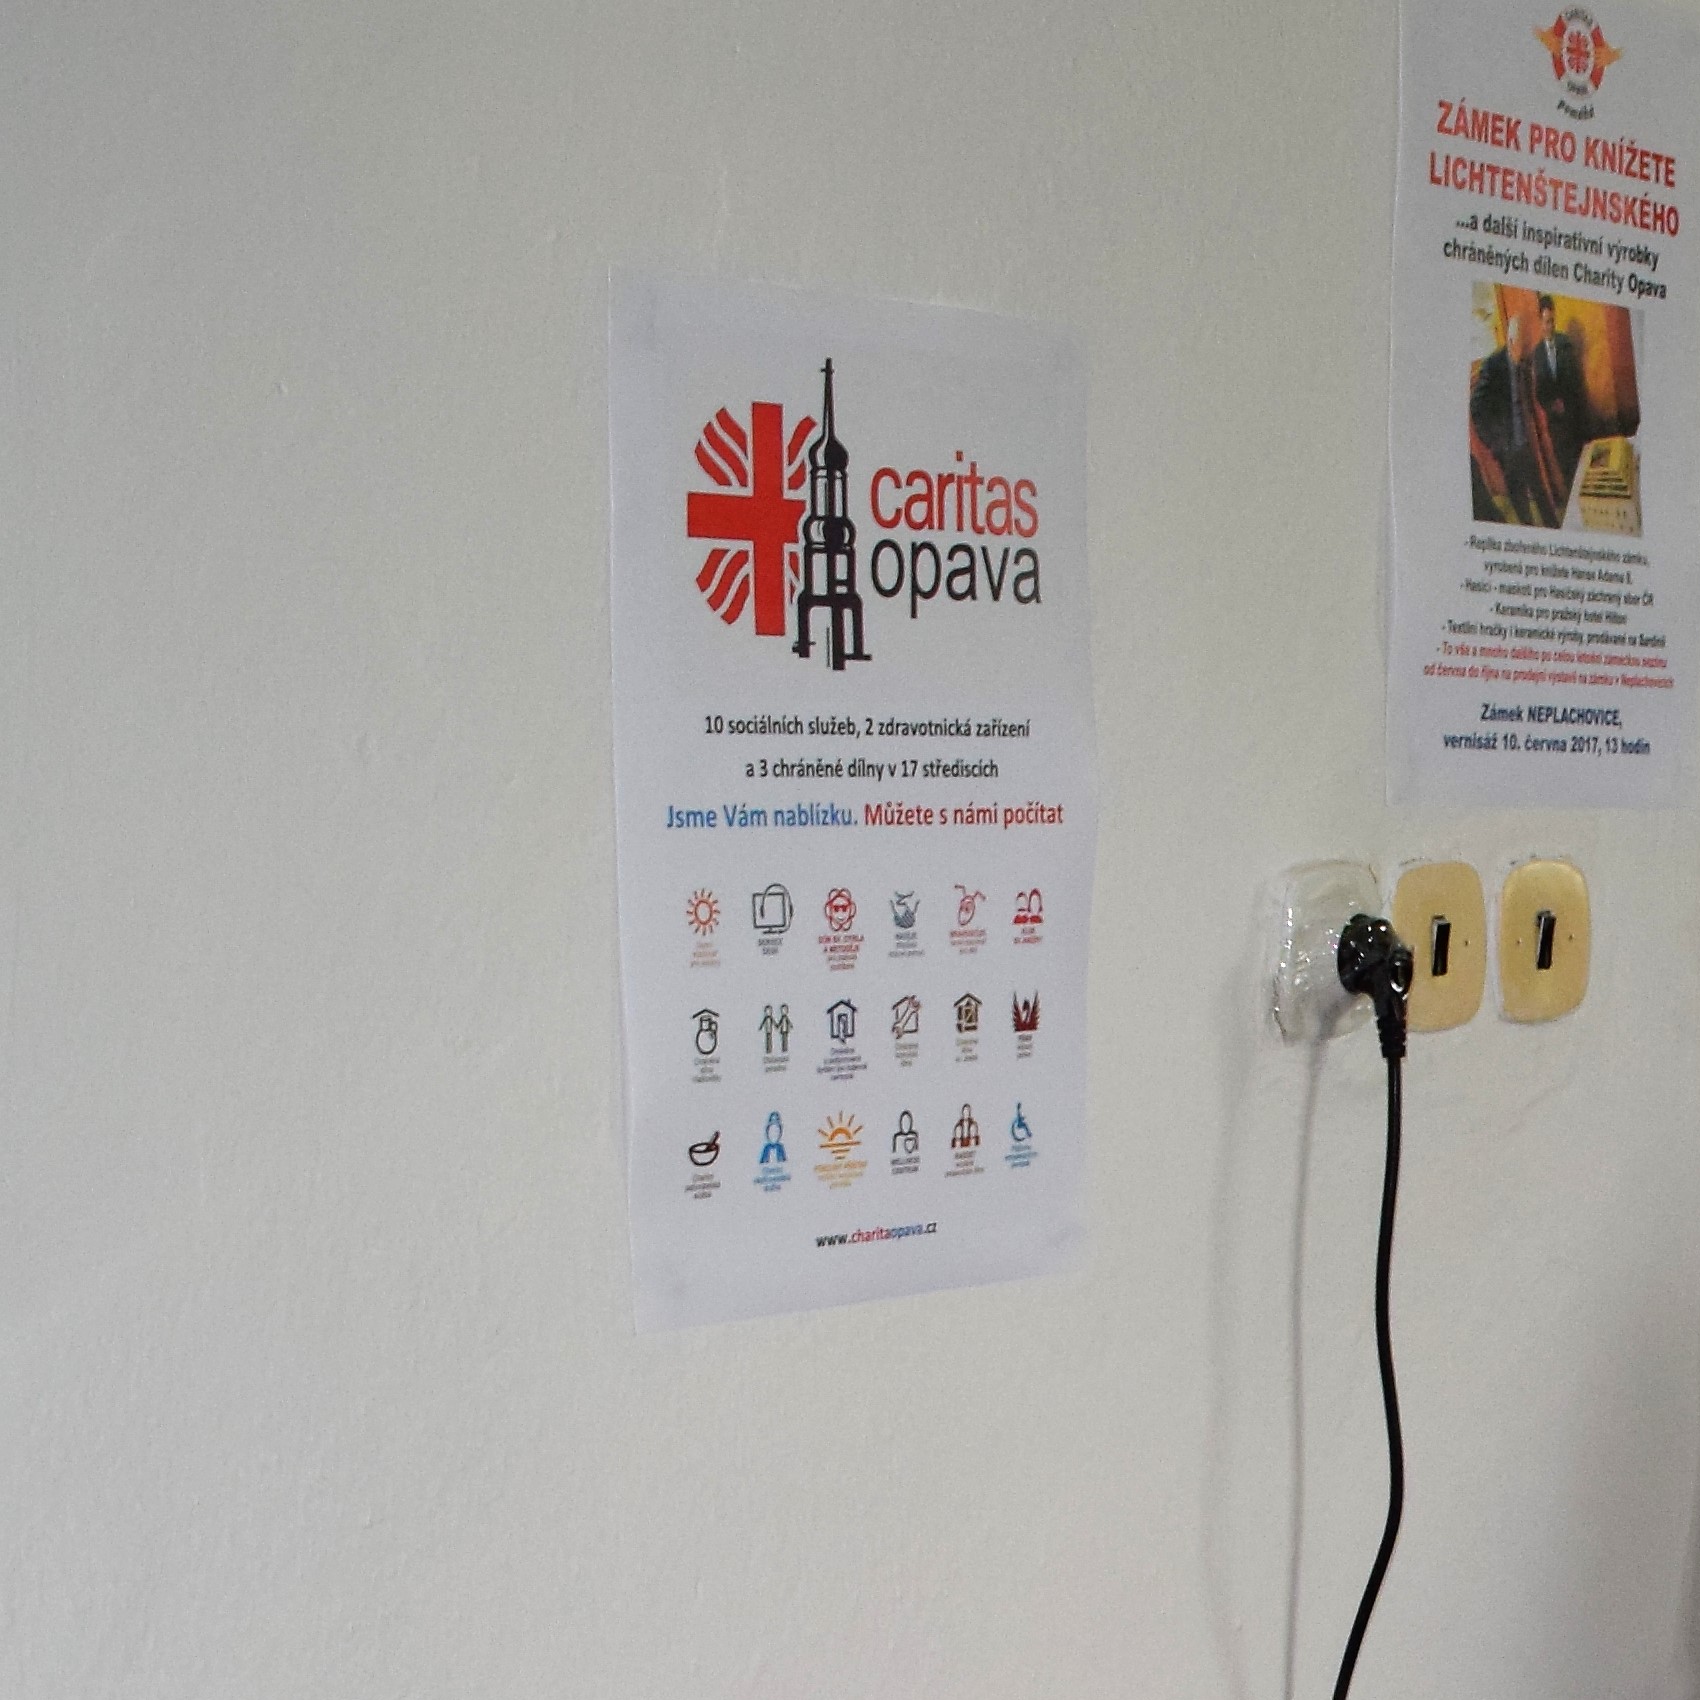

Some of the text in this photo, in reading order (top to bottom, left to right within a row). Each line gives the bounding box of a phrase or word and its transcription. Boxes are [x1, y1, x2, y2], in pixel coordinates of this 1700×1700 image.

[1436, 97, 1676, 188] ZÁMEK PRO KNÍŽETE
[1429, 151, 1680, 237] LICHTENŠTEJNSKÉHO
[1482, 213, 1518, 239] další
[1522, 221, 1604, 255] inspirativní
[1607, 239, 1660, 272] výrobky
[1443, 237, 1668, 300] chráněných dílen Charity Opava
[870, 451, 1040, 538] caritas
[870, 538, 1043, 620] opava
[704, 714, 1031, 739] 10 sociálních služeb, 2 zdravotnická zařízení
[1479, 702, 1623, 730] Zámek NEPLACHOVICE,
[1442, 730, 1498, 751] vernisáž
[1502, 734, 1521, 751] 10.
[1524, 734, 1568, 753] června
[1571, 736, 1602, 757] 2017,
[1605, 737, 1618, 754] 13
[745, 757, 999, 782] a 3 chráněné dílny v 17 střediscích
[666, 800, 1065, 830] Jsme Vám nablízku. Můžete s námi počítat
[815, 1220, 938, 1248] www.charitaopava.cz
